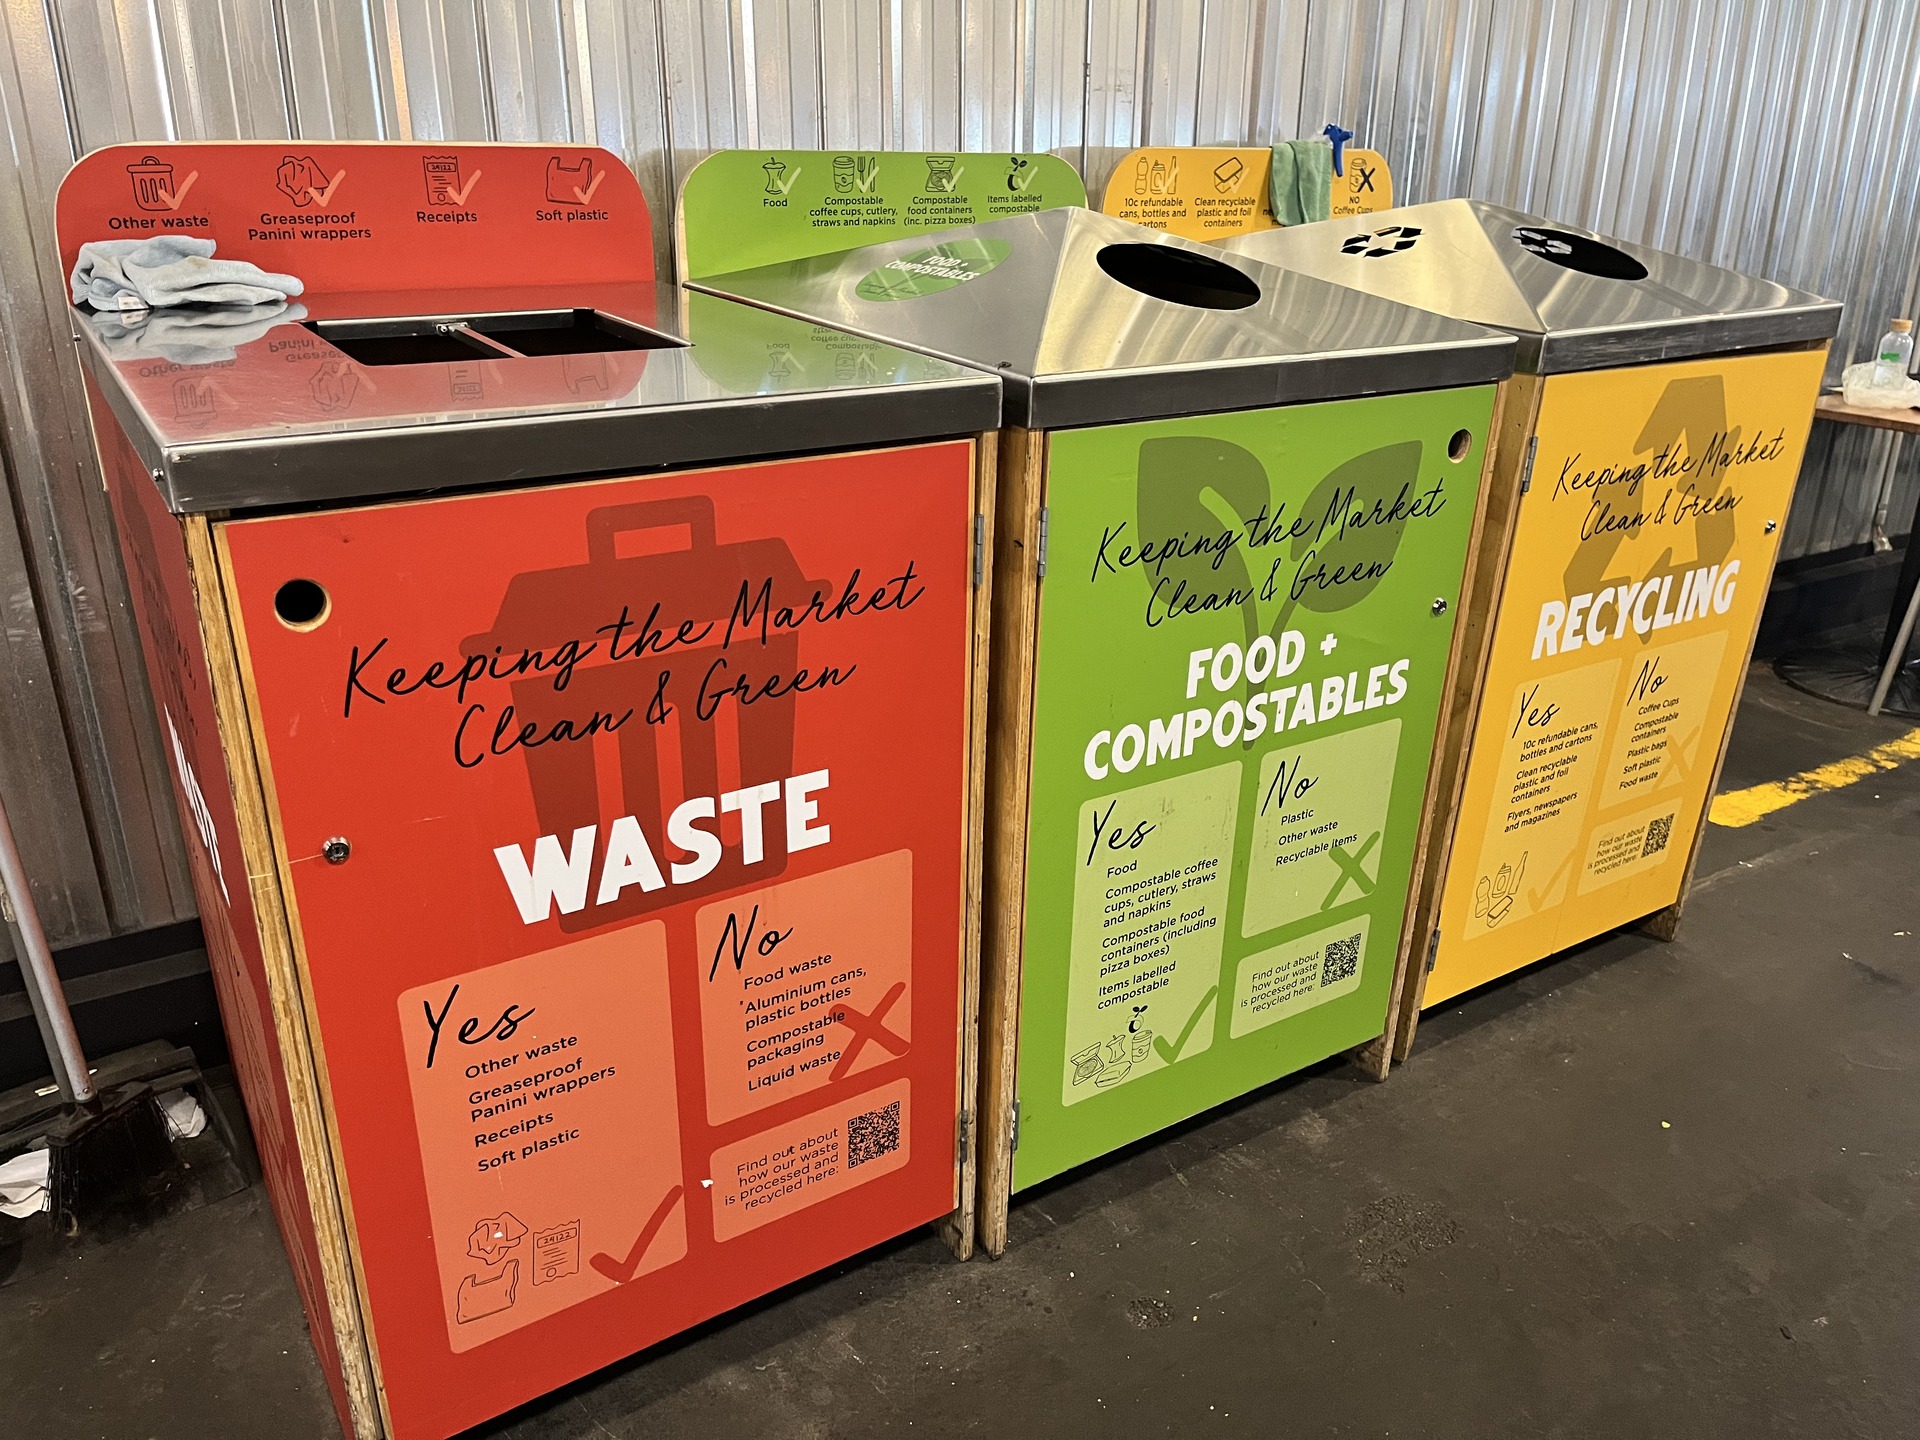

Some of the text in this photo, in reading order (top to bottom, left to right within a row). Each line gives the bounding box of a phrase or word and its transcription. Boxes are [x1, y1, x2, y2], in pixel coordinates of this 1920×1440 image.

[763, 198, 787, 207] Food
[809, 206, 898, 218] coffee cups, cutlery,
[824, 196, 884, 206] Compostable
[907, 206, 973, 215] food containers
[912, 196, 968, 206] Compostable
[987, 194, 1042, 204] Items labelled
[989, 204, 1040, 214] compostable
[1119, 208, 1187, 219] cans, bottles and
[1124, 197, 1183, 207] 10c refundable
[1194, 196, 1256, 207] Clean recyclable
[1197, 207, 1223, 218] plastic
[1224, 208, 1237, 217] and
[1239, 207, 1252, 217] foil
[1349, 196, 1360, 205] NO
[109, 215, 209, 230] Other waste
[260, 212, 356, 227] Greaseproof
[416, 211, 477, 224] Receipts
[536, 209, 608, 222] Soft plastic
[812, 217, 896, 227] straws and napkins
[903, 215, 976, 226] (inc. pizza boxes)
[1204, 218, 1242, 228] containers
[248, 228, 371, 241] Panini wrappers
[1552, 427, 1785, 502] Keeping the Market
[1580, 483, 1743, 541] Clean & Green
[1091, 477, 1447, 583] Keeping the Market
[1146, 550, 1394, 628] Clean & Green
[1530, 559, 1741, 661] RECYCLING
[343, 560, 926, 718] Keeping the Market
[1185, 629, 1338, 700] FOOD +
[1627, 656, 1668, 706] No
[454, 658, 857, 769] Clean & Green
[1083, 658, 1411, 781] COMPOSTABLES
[1512, 684, 1560, 739] Yes
[1634, 711, 1679, 731] Compostable
[1638, 697, 1680, 715] Coffee Cups
[1520, 734, 1592, 762] bottles and cartons
[1523, 740, 1536, 750] 10c
[1538, 726, 1578, 746] refundable
[1627, 739, 1667, 759] Plastic bags
[1631, 726, 1667, 743] containers
[1513, 766, 1569, 794] plastic and foil
[1516, 754, 1578, 780] Clean recyclable
[1619, 771, 1659, 790] Food waste
[1623, 756, 1661, 775] Soft plastic
[1261, 755, 1319, 817] No
[1511, 785, 1551, 804] containers
[1281, 808, 1314, 826] Plastic
[1504, 808, 1561, 833] and magazines
[1507, 792, 1578, 822] Flyers, newspapers
[493, 768, 831, 925] WASTE
[1086, 799, 1157, 866] Yes
[1278, 821, 1338, 846] Other waste
[1276, 834, 1358, 866] Recyclable items
[1105, 857, 1219, 900] Compostable coffee
[1107, 859, 1138, 879] Food
[1104, 871, 1217, 914] cups, cutlery, straws
[1102, 906, 1206, 949] Compostable food
[1103, 898, 1171, 928] and napkins
[709, 904, 794, 983] No
[1101, 916, 1217, 963] containers (including
[744, 953, 832, 990] Food waste
[1099, 945, 1170, 978] pizza boxes)
[1252, 951, 1320, 983] Find out about
[744, 966, 867, 1014] Aluminium cans,
[1097, 977, 1170, 1010] compostable
[1099, 961, 1177, 997] Items labelled
[1252, 963, 1318, 993] how our waste
[745, 985, 851, 1032] plastic bottles
[423, 984, 536, 1068] Yes
[746, 1010, 845, 1052] Compostable
[465, 1035, 578, 1079] Other waste
[747, 1033, 825, 1070] packaging
[468, 1057, 583, 1105] Greaseproof
[748, 1050, 841, 1091] Liquid waste
[470, 1066, 616, 1123] Panini wrappers
[474, 1112, 554, 1148] Receipts
[478, 1128, 580, 1172] Soft plastic
[737, 1128, 839, 1176] Find out about
[739, 1141, 839, 1188] how our waste
[725, 1152, 839, 1206] is processed and
[745, 1165, 839, 1210] recycled here:
[543, 1231, 571, 1245] 24122
